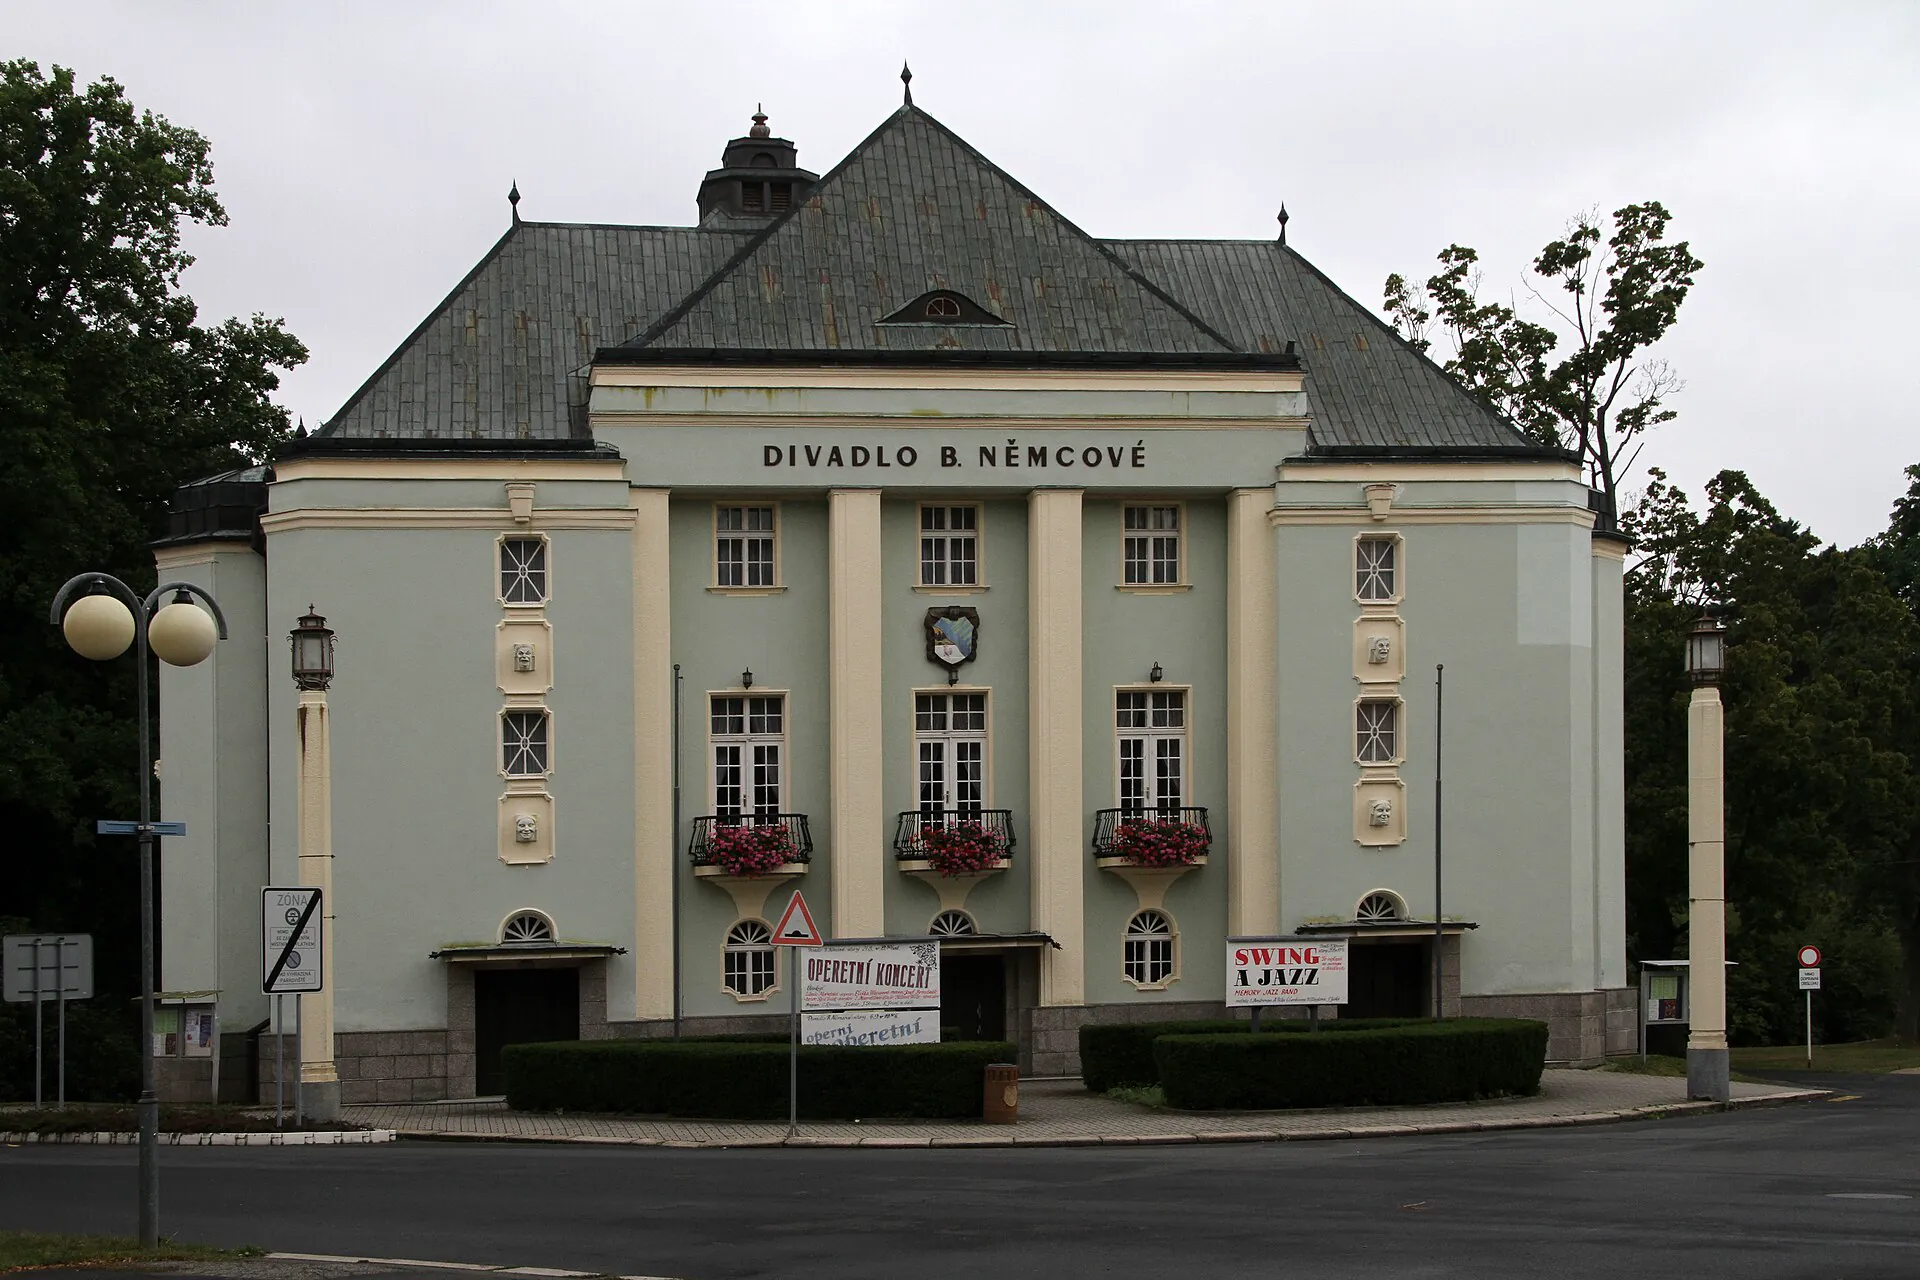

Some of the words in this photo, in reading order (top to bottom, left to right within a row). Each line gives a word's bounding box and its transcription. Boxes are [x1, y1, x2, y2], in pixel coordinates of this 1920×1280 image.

[763, 445, 918, 468] DIVADLO
[940, 445, 962, 468] B.
[979, 439, 1146, 468] NĚMCOVÉ
[276, 892, 308, 907] ZÓNA
[1234, 947, 1321, 966] SWING
[808, 958, 873, 985] OPERETNÍ
[875, 962, 933, 989] KONCERT
[1233, 969, 1251, 987] A
[1257, 968, 1320, 986] JAZZ
[1234, 989, 1261, 997] MEMORY
[1263, 988, 1279, 996] JAZZ
[1281, 988, 1299, 996] BAND
